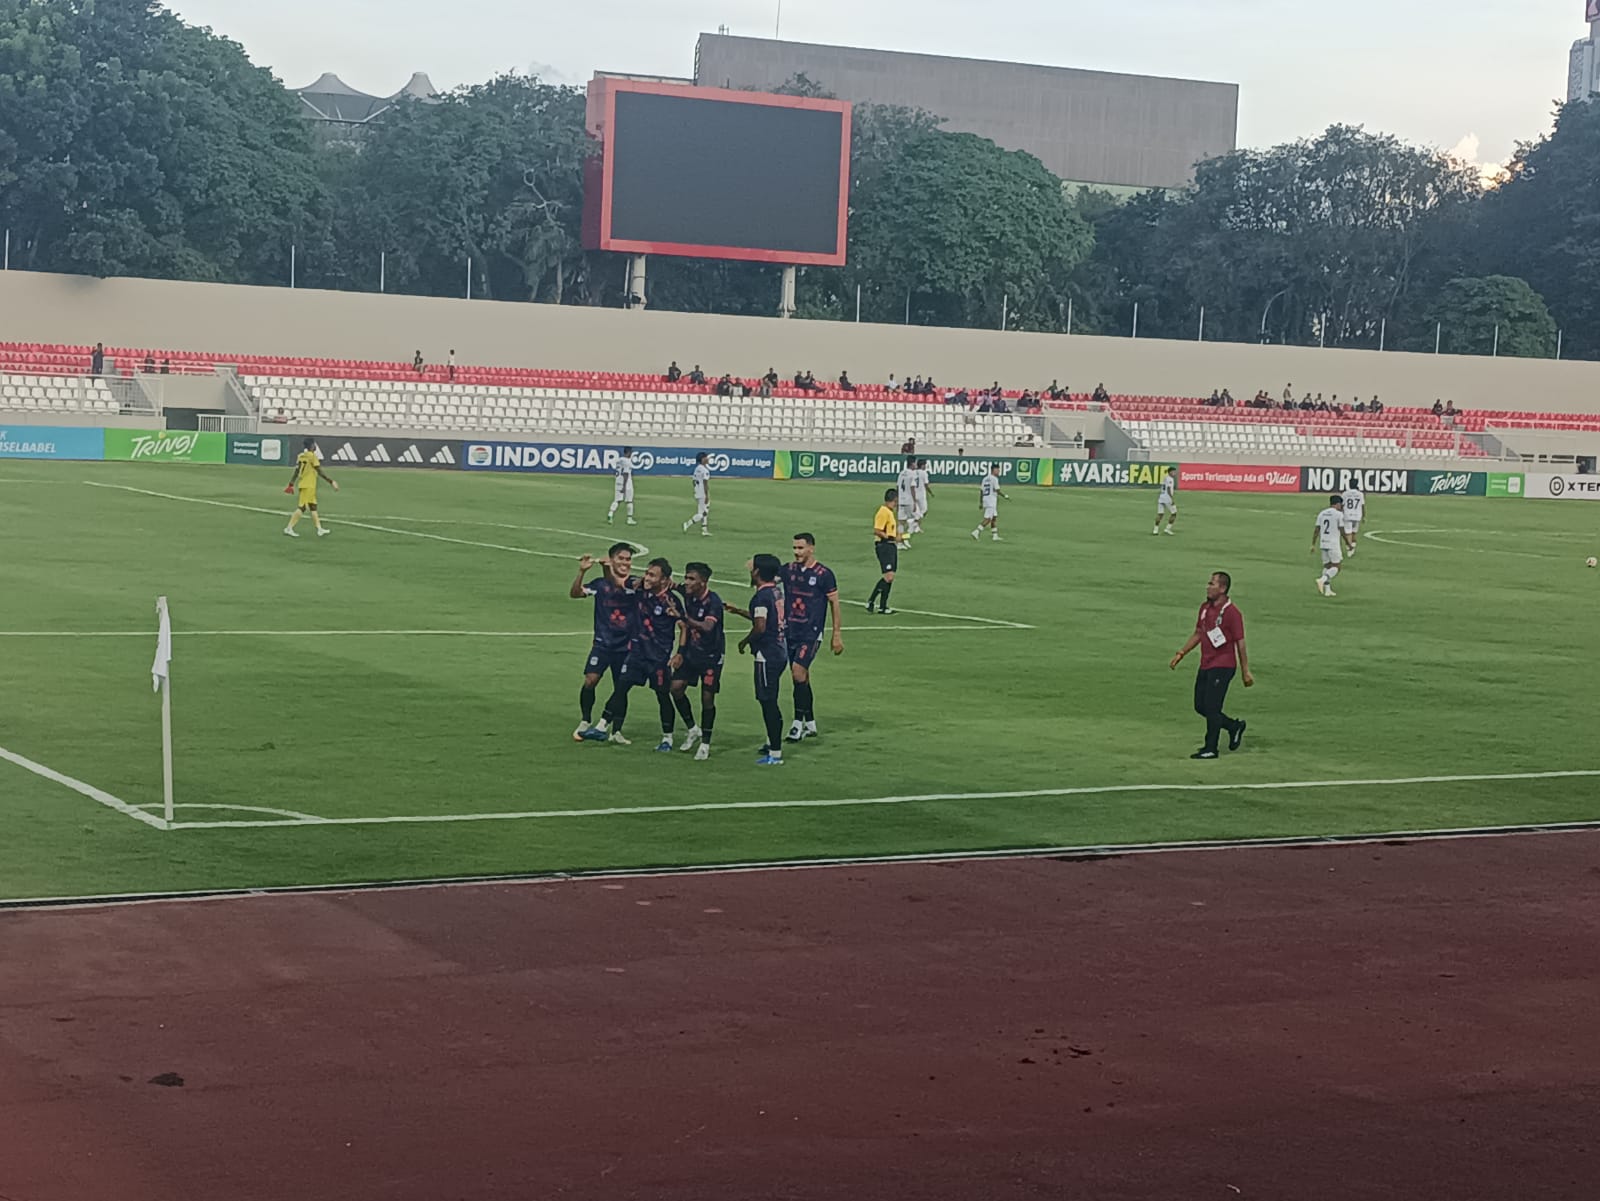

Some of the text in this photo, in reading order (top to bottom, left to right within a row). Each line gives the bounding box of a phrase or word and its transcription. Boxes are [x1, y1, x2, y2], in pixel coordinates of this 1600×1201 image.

[495, 446, 620, 469] INDOSIAR
[903, 458, 1012, 476] AMPIONSHIP
[1307, 468, 1408, 492] NO RACISM
[1346, 498, 1361, 510] 87
[1323, 519, 1331, 535] 2
